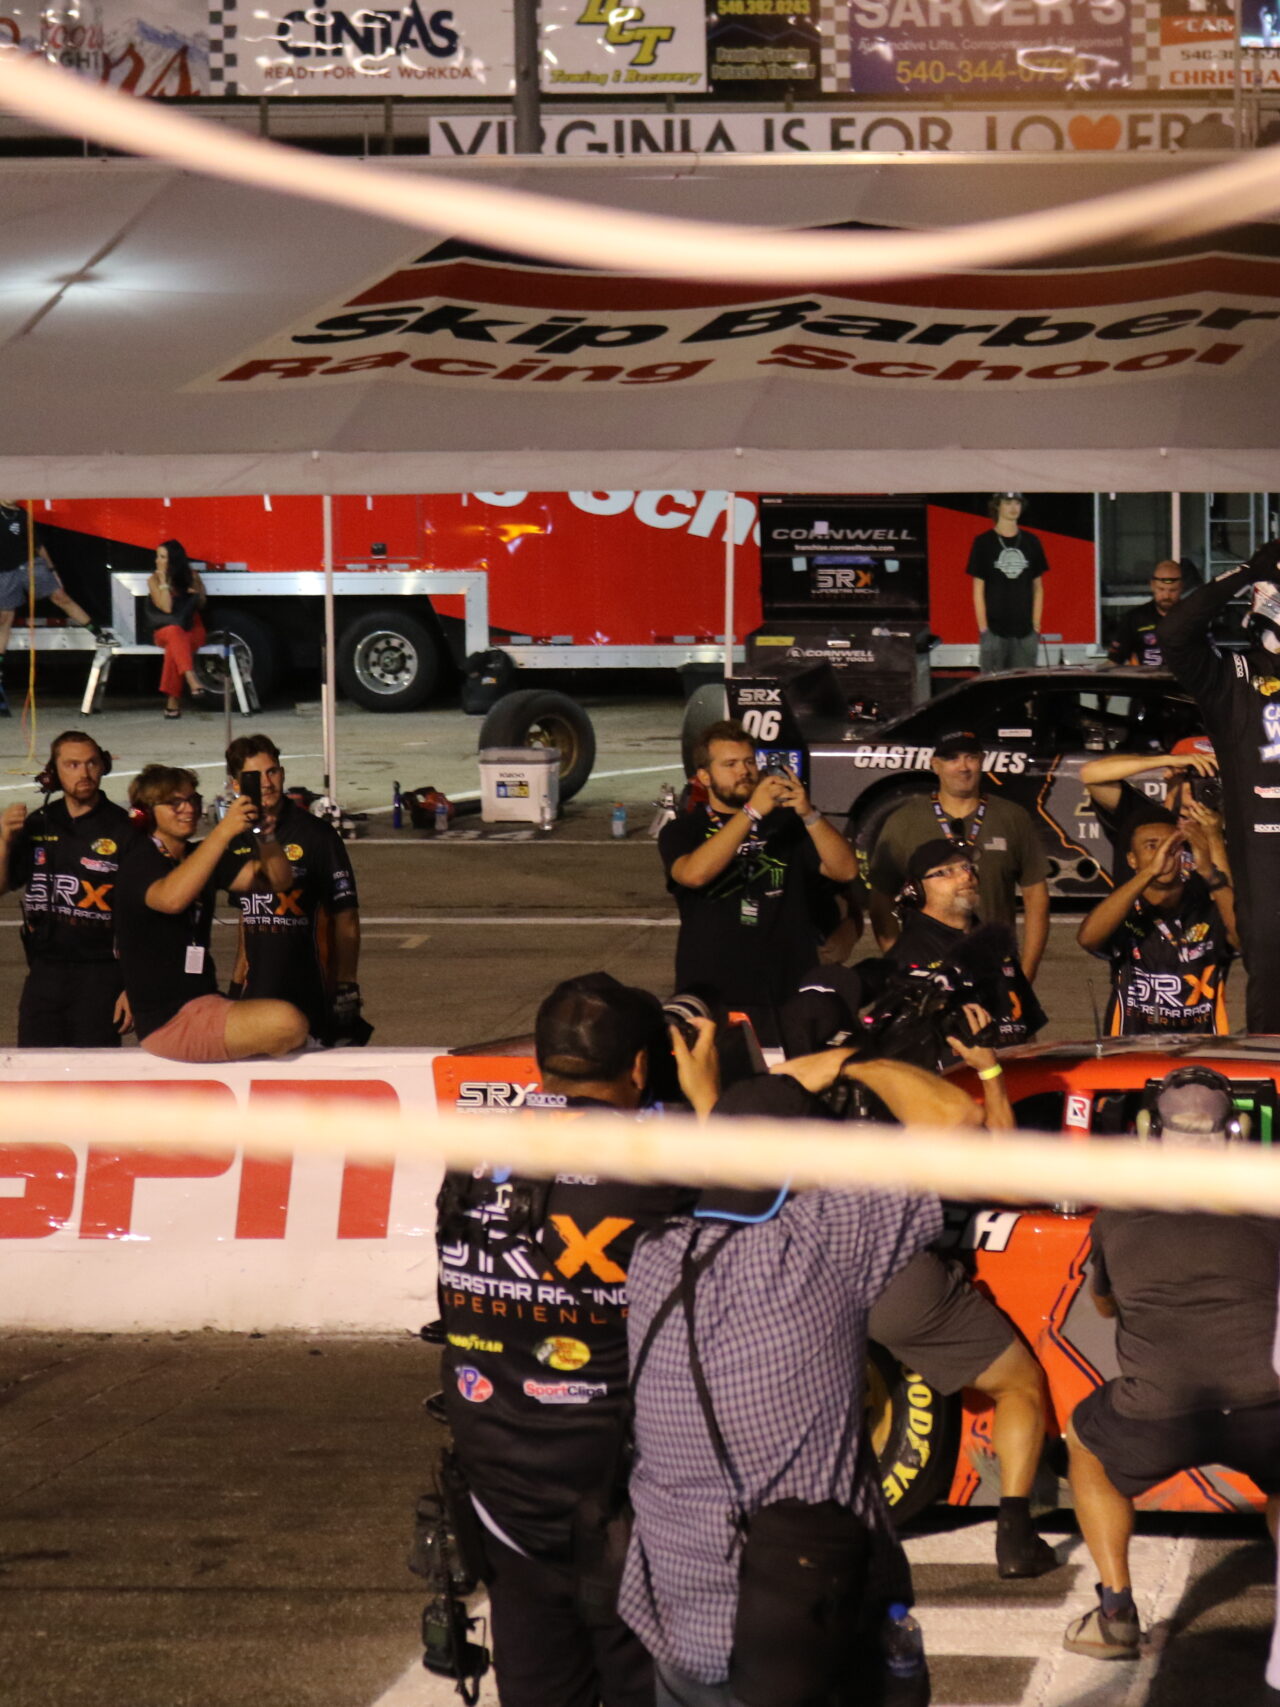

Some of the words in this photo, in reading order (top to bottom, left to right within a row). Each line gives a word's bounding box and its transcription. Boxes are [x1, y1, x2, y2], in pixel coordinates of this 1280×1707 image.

[400, 67, 474, 79] WORKDA
[439, 119, 737, 155] VIGINIA
[292, 305, 670, 354] Skip
[218, 351, 715, 384] Racing
[757, 343, 1244, 381] School
[817, 569, 873, 588] SRX
[738, 688, 782, 701] SRX
[854, 745, 1027, 774] CASTRVES
[25, 873, 113, 912] SRX
[1127, 965, 1217, 1007] SRX
[441, 1268, 532, 1302] PERSTAR
